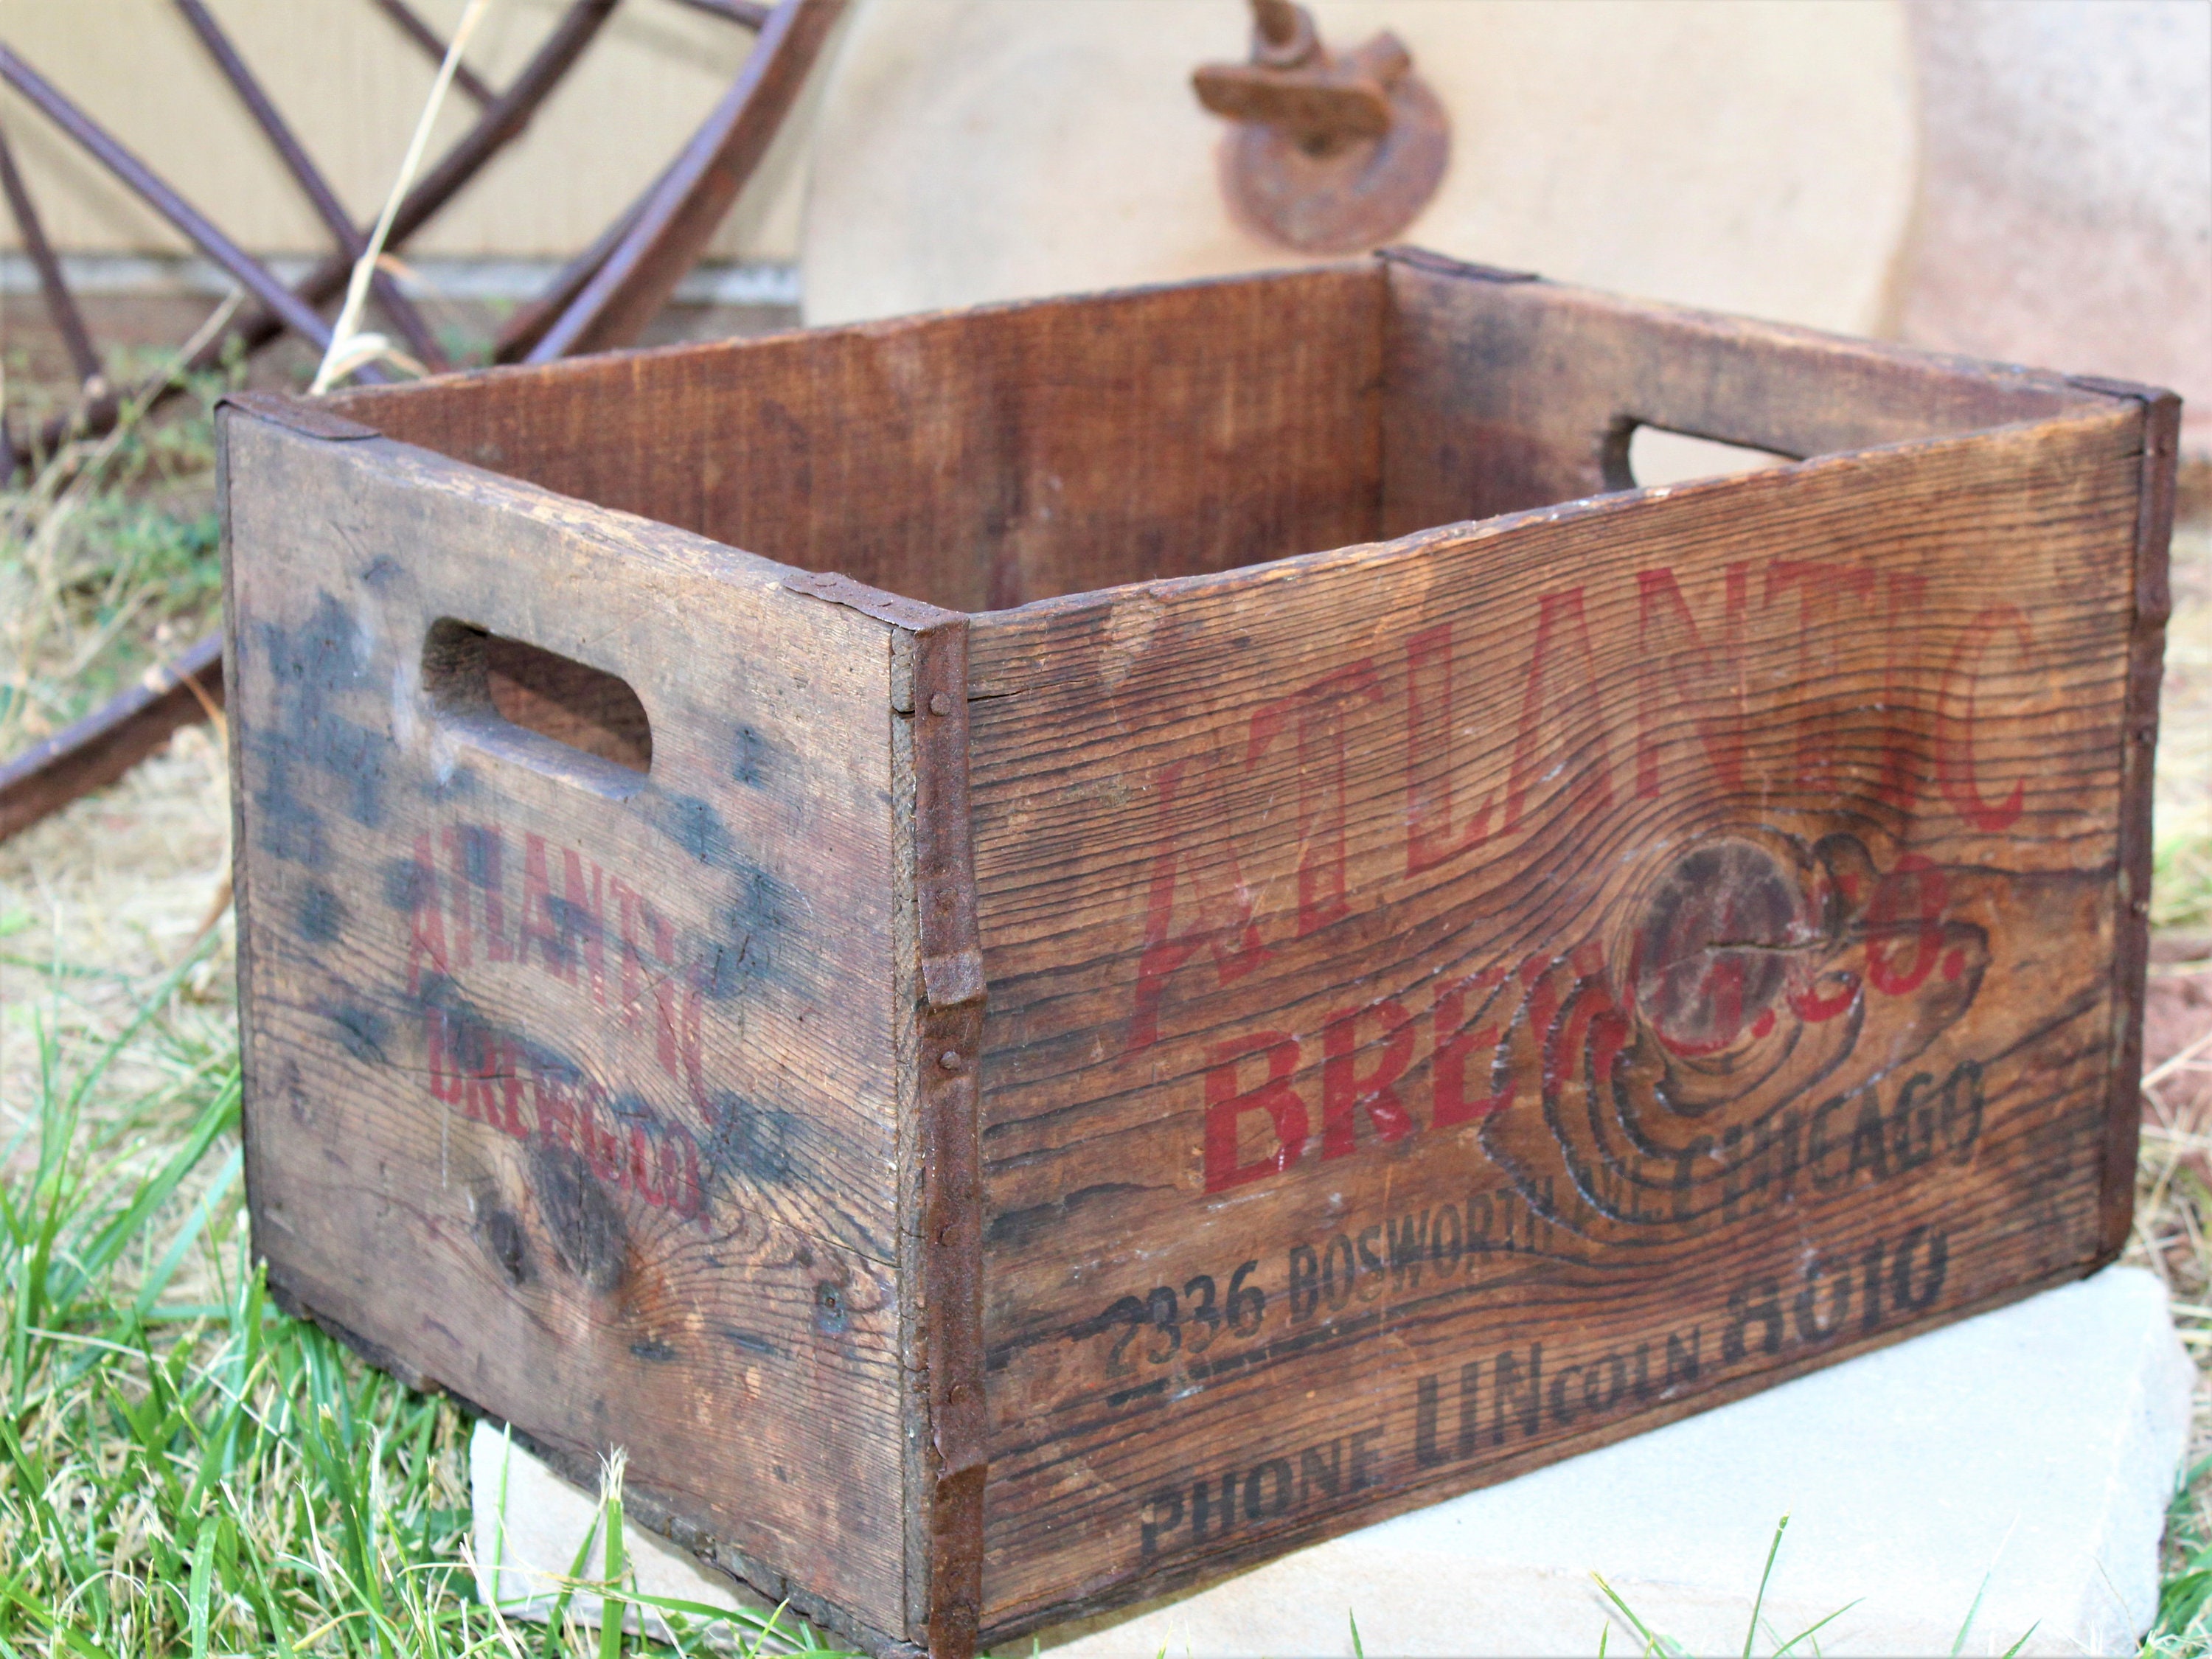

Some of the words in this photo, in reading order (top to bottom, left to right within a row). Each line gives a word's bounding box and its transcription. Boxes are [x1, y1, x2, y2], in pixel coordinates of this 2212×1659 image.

[1124, 557, 2034, 1056] ATLANTIC
[1106, 1259, 1265, 1377] 2336
[1289, 1175, 1554, 1324] BOSWORTH
[1141, 1425, 1384, 1556] PHONE
